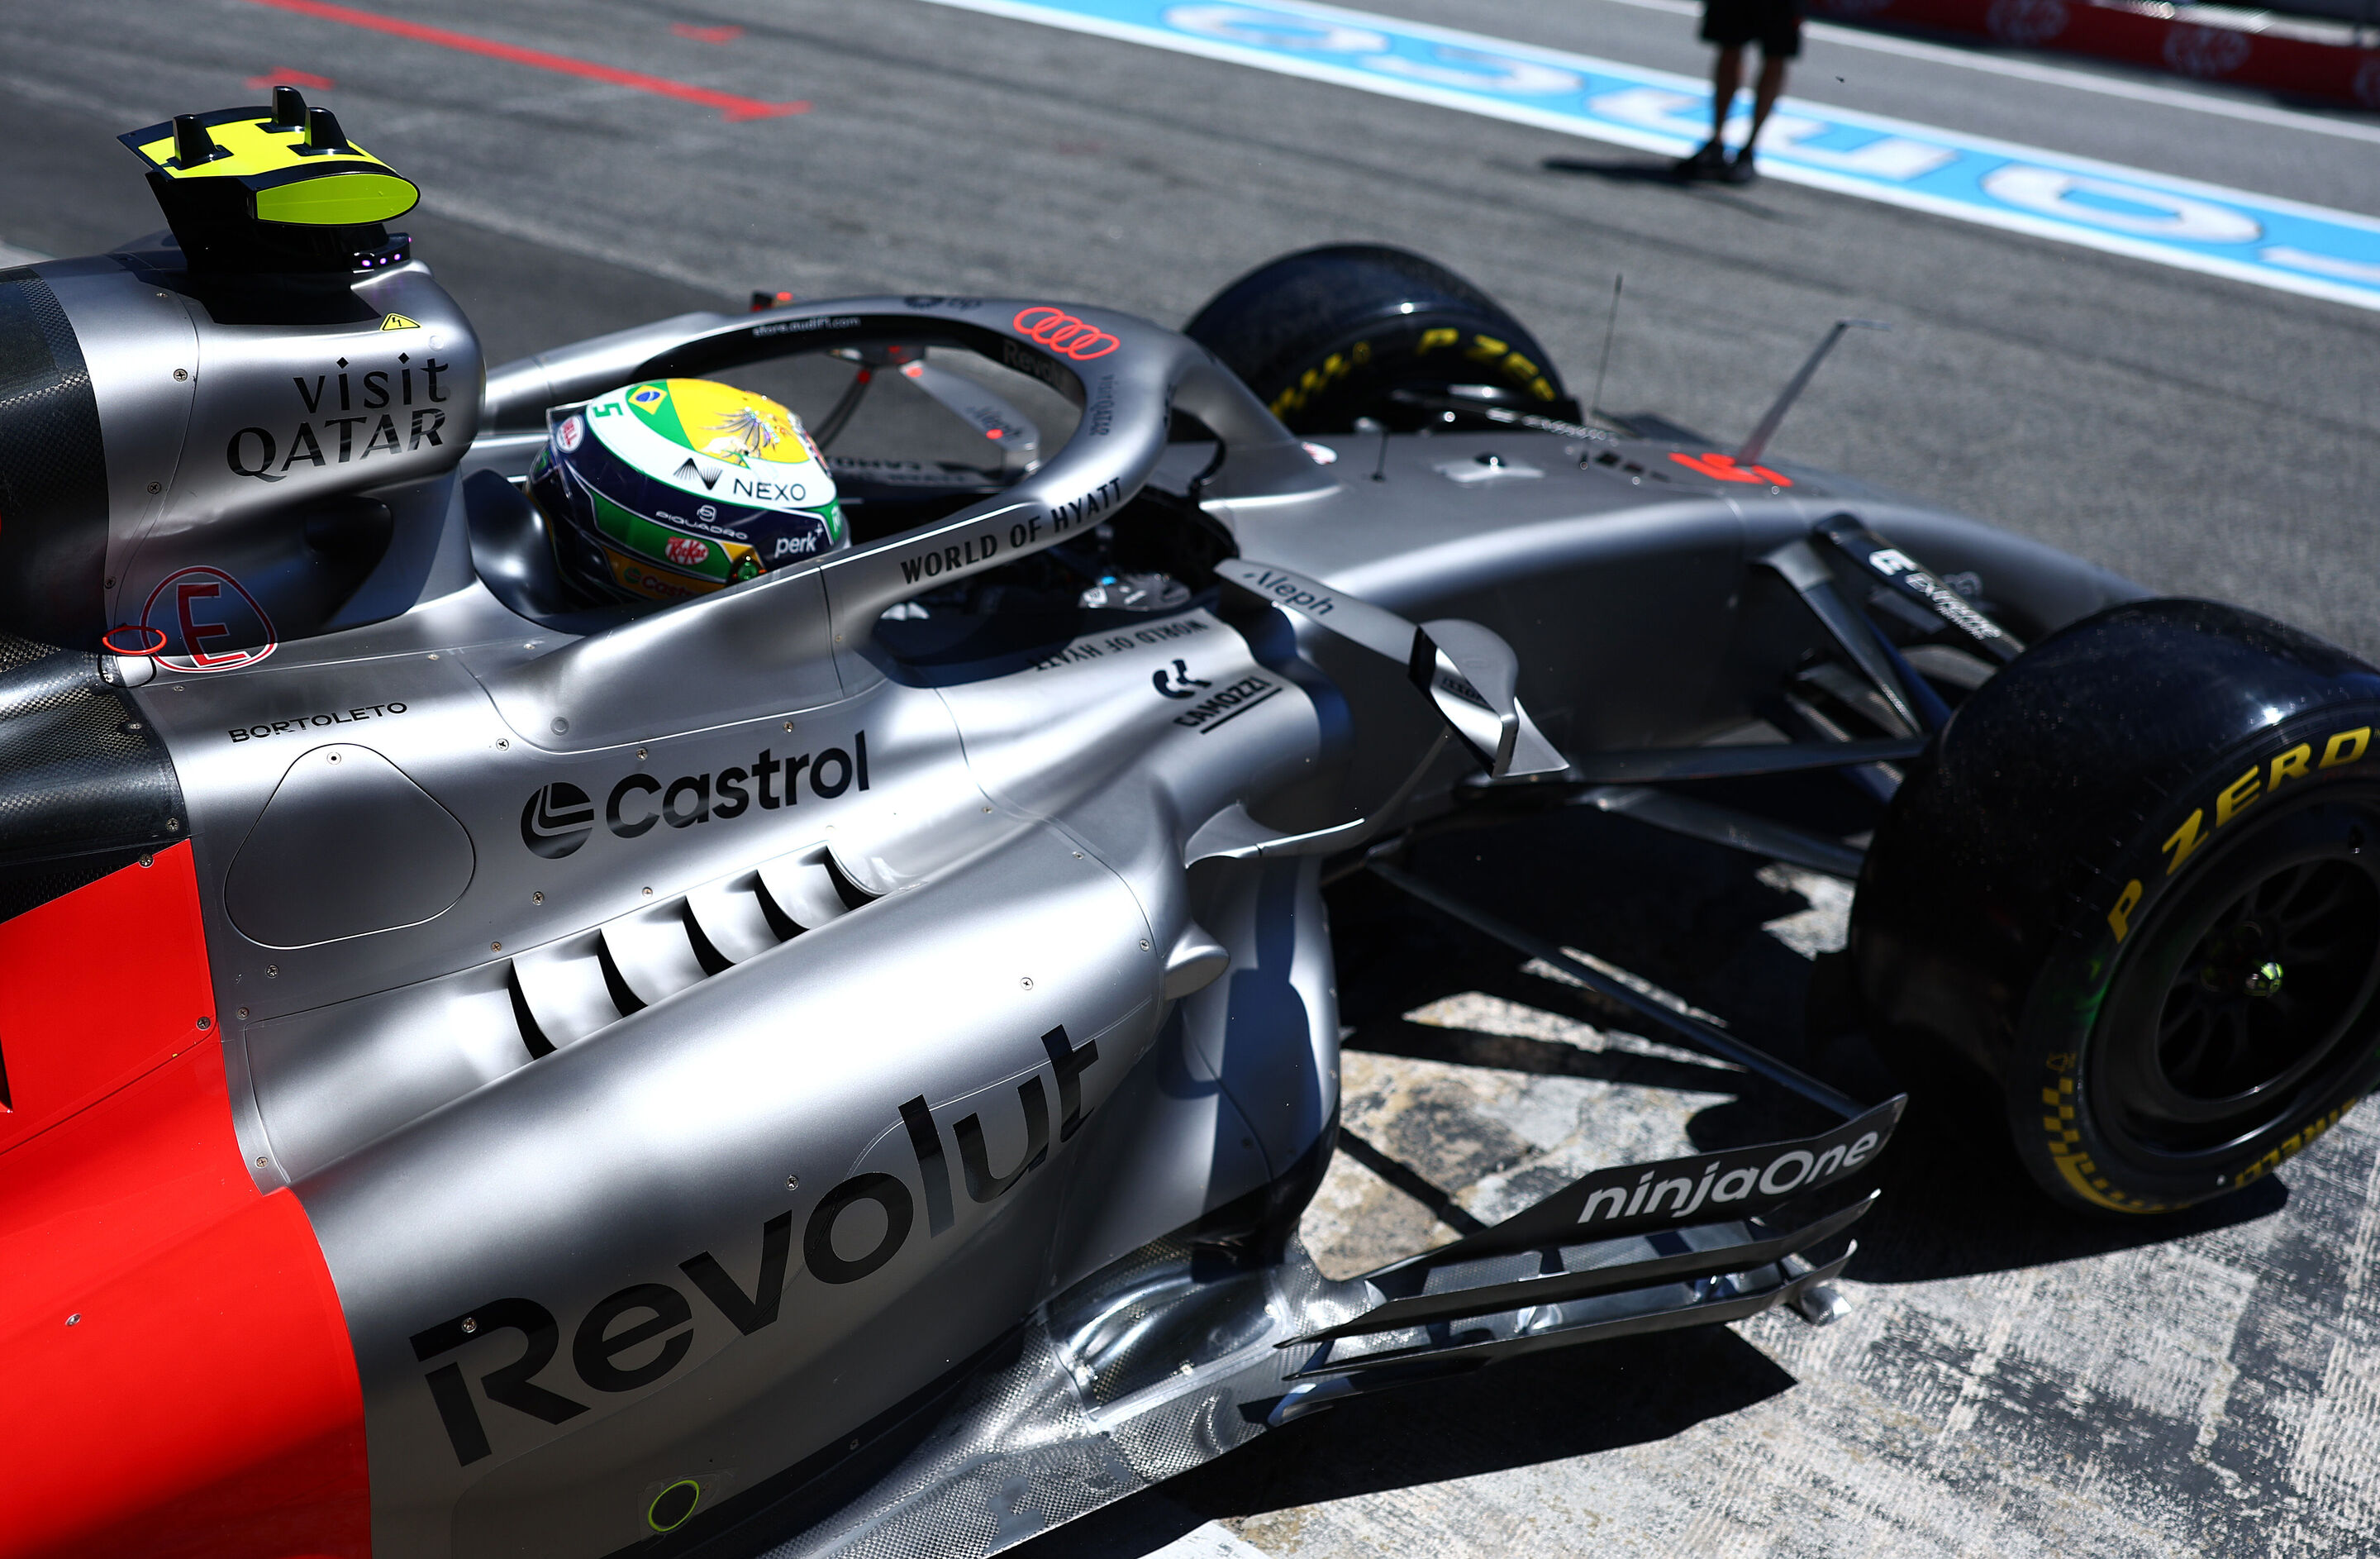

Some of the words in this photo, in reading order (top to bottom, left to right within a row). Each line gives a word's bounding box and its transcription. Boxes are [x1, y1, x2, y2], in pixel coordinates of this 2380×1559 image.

[293, 353, 449, 414] visit
[592, 402, 624, 418] 5
[226, 408, 445, 483] QATAR
[732, 478, 807, 501] NEXO
[655, 510, 749, 541] PIQUADRO
[899, 534, 998, 586] WORLD
[1009, 515, 1042, 547] OF
[1050, 476, 1122, 534] HYATT
[1243, 571, 1336, 617] Aleph
[177, 583, 249, 665] E
[1104, 636, 1135, 653] OF
[1135, 619, 1209, 645] WORLD
[228, 702, 407, 743] BORTOLETO
[1173, 675, 1273, 727] CAMOZZI
[605, 729, 870, 839] Castrol
[2106, 879, 2143, 944] P
[2161, 726, 2372, 876] ZERO
[1577, 1131, 1880, 1225] ninjaOne
[408, 1023, 1099, 1467] Revolut
